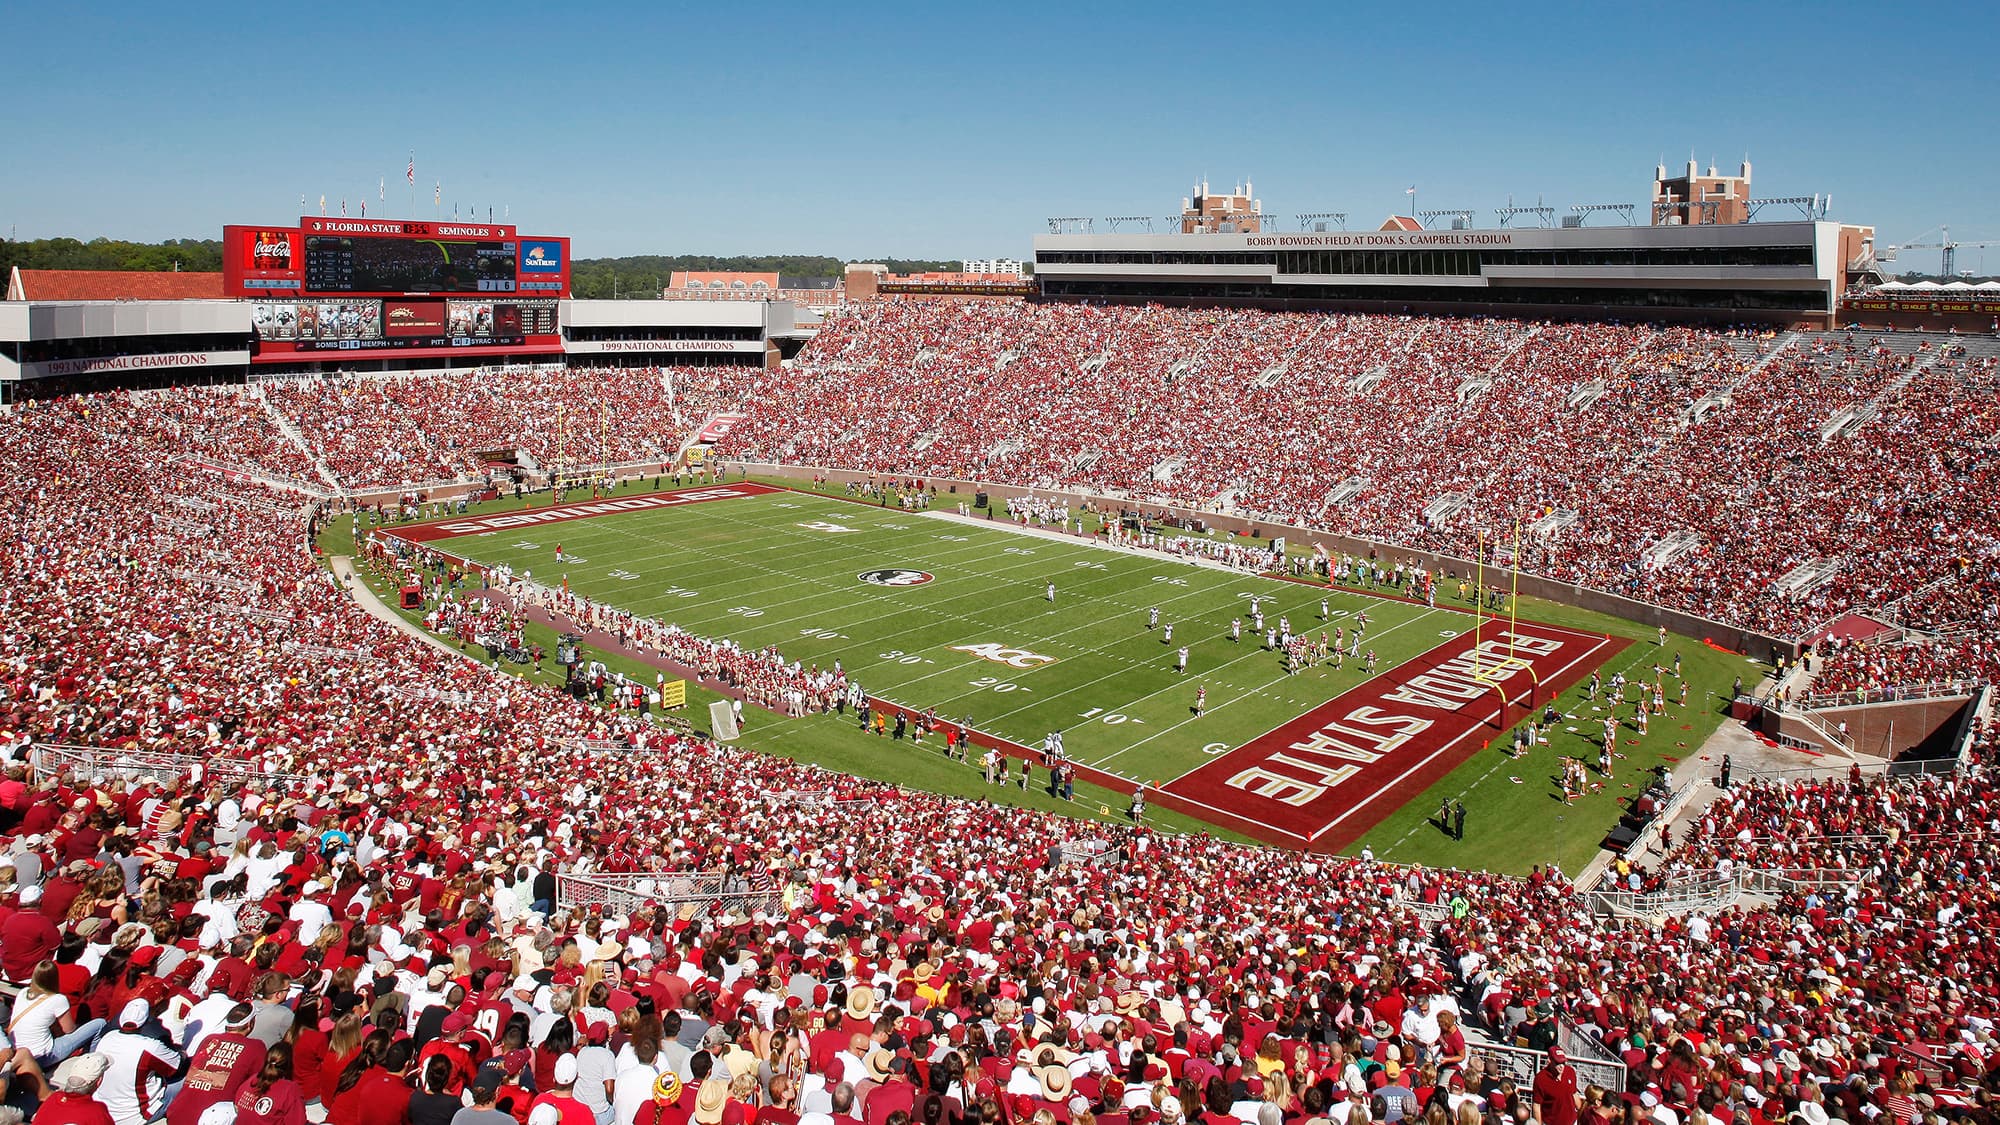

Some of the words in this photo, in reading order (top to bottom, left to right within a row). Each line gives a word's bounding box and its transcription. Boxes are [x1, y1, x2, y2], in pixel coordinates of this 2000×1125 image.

[326, 222, 370, 232] FLORIDA
[371, 224, 400, 233] STATE
[438, 227, 490, 236] SEMINOLES
[1246, 237, 1276, 246] BOBBY
[1280, 236, 1322, 246] BOWDEN
[1325, 236, 1350, 245] FIELD
[1354, 236, 1364, 245] AT
[1367, 236, 1396, 245] DOAK
[1398, 236, 1407, 244] S.
[1410, 236, 1460, 244] CAMPBELL
[1464, 234, 1512, 244] STADIUM
[486, 281, 490, 289] 7
[504, 282, 510, 290] 6
[625, 342, 673, 350] NATIONAL
[675, 342, 734, 350] CHAMPIONS
[48, 364, 70, 374] 1993
[72, 357, 128, 371] NATIONAL
[132, 354, 207, 367] CHAMPIONS
[437, 488, 747, 533] SEMINOLES
[608, 569, 640, 580] 30
[665, 586, 699, 598] 40
[728, 606, 764, 618] 50
[800, 628, 838, 640] 40
[880, 650, 922, 664] 30
[944, 642, 1061, 670] ACC
[1380, 630, 1564, 710] FLORIDA
[969, 677, 1018, 692] 20
[1078, 707, 1128, 724] 10
[1203, 742, 1230, 754] G
[1224, 706, 1435, 807] STATE
[396, 876, 413, 887] FSU
[214, 1048, 240, 1060] DOAK
[210, 1056, 236, 1069] BACK
[188, 1080, 212, 1092] 2010
